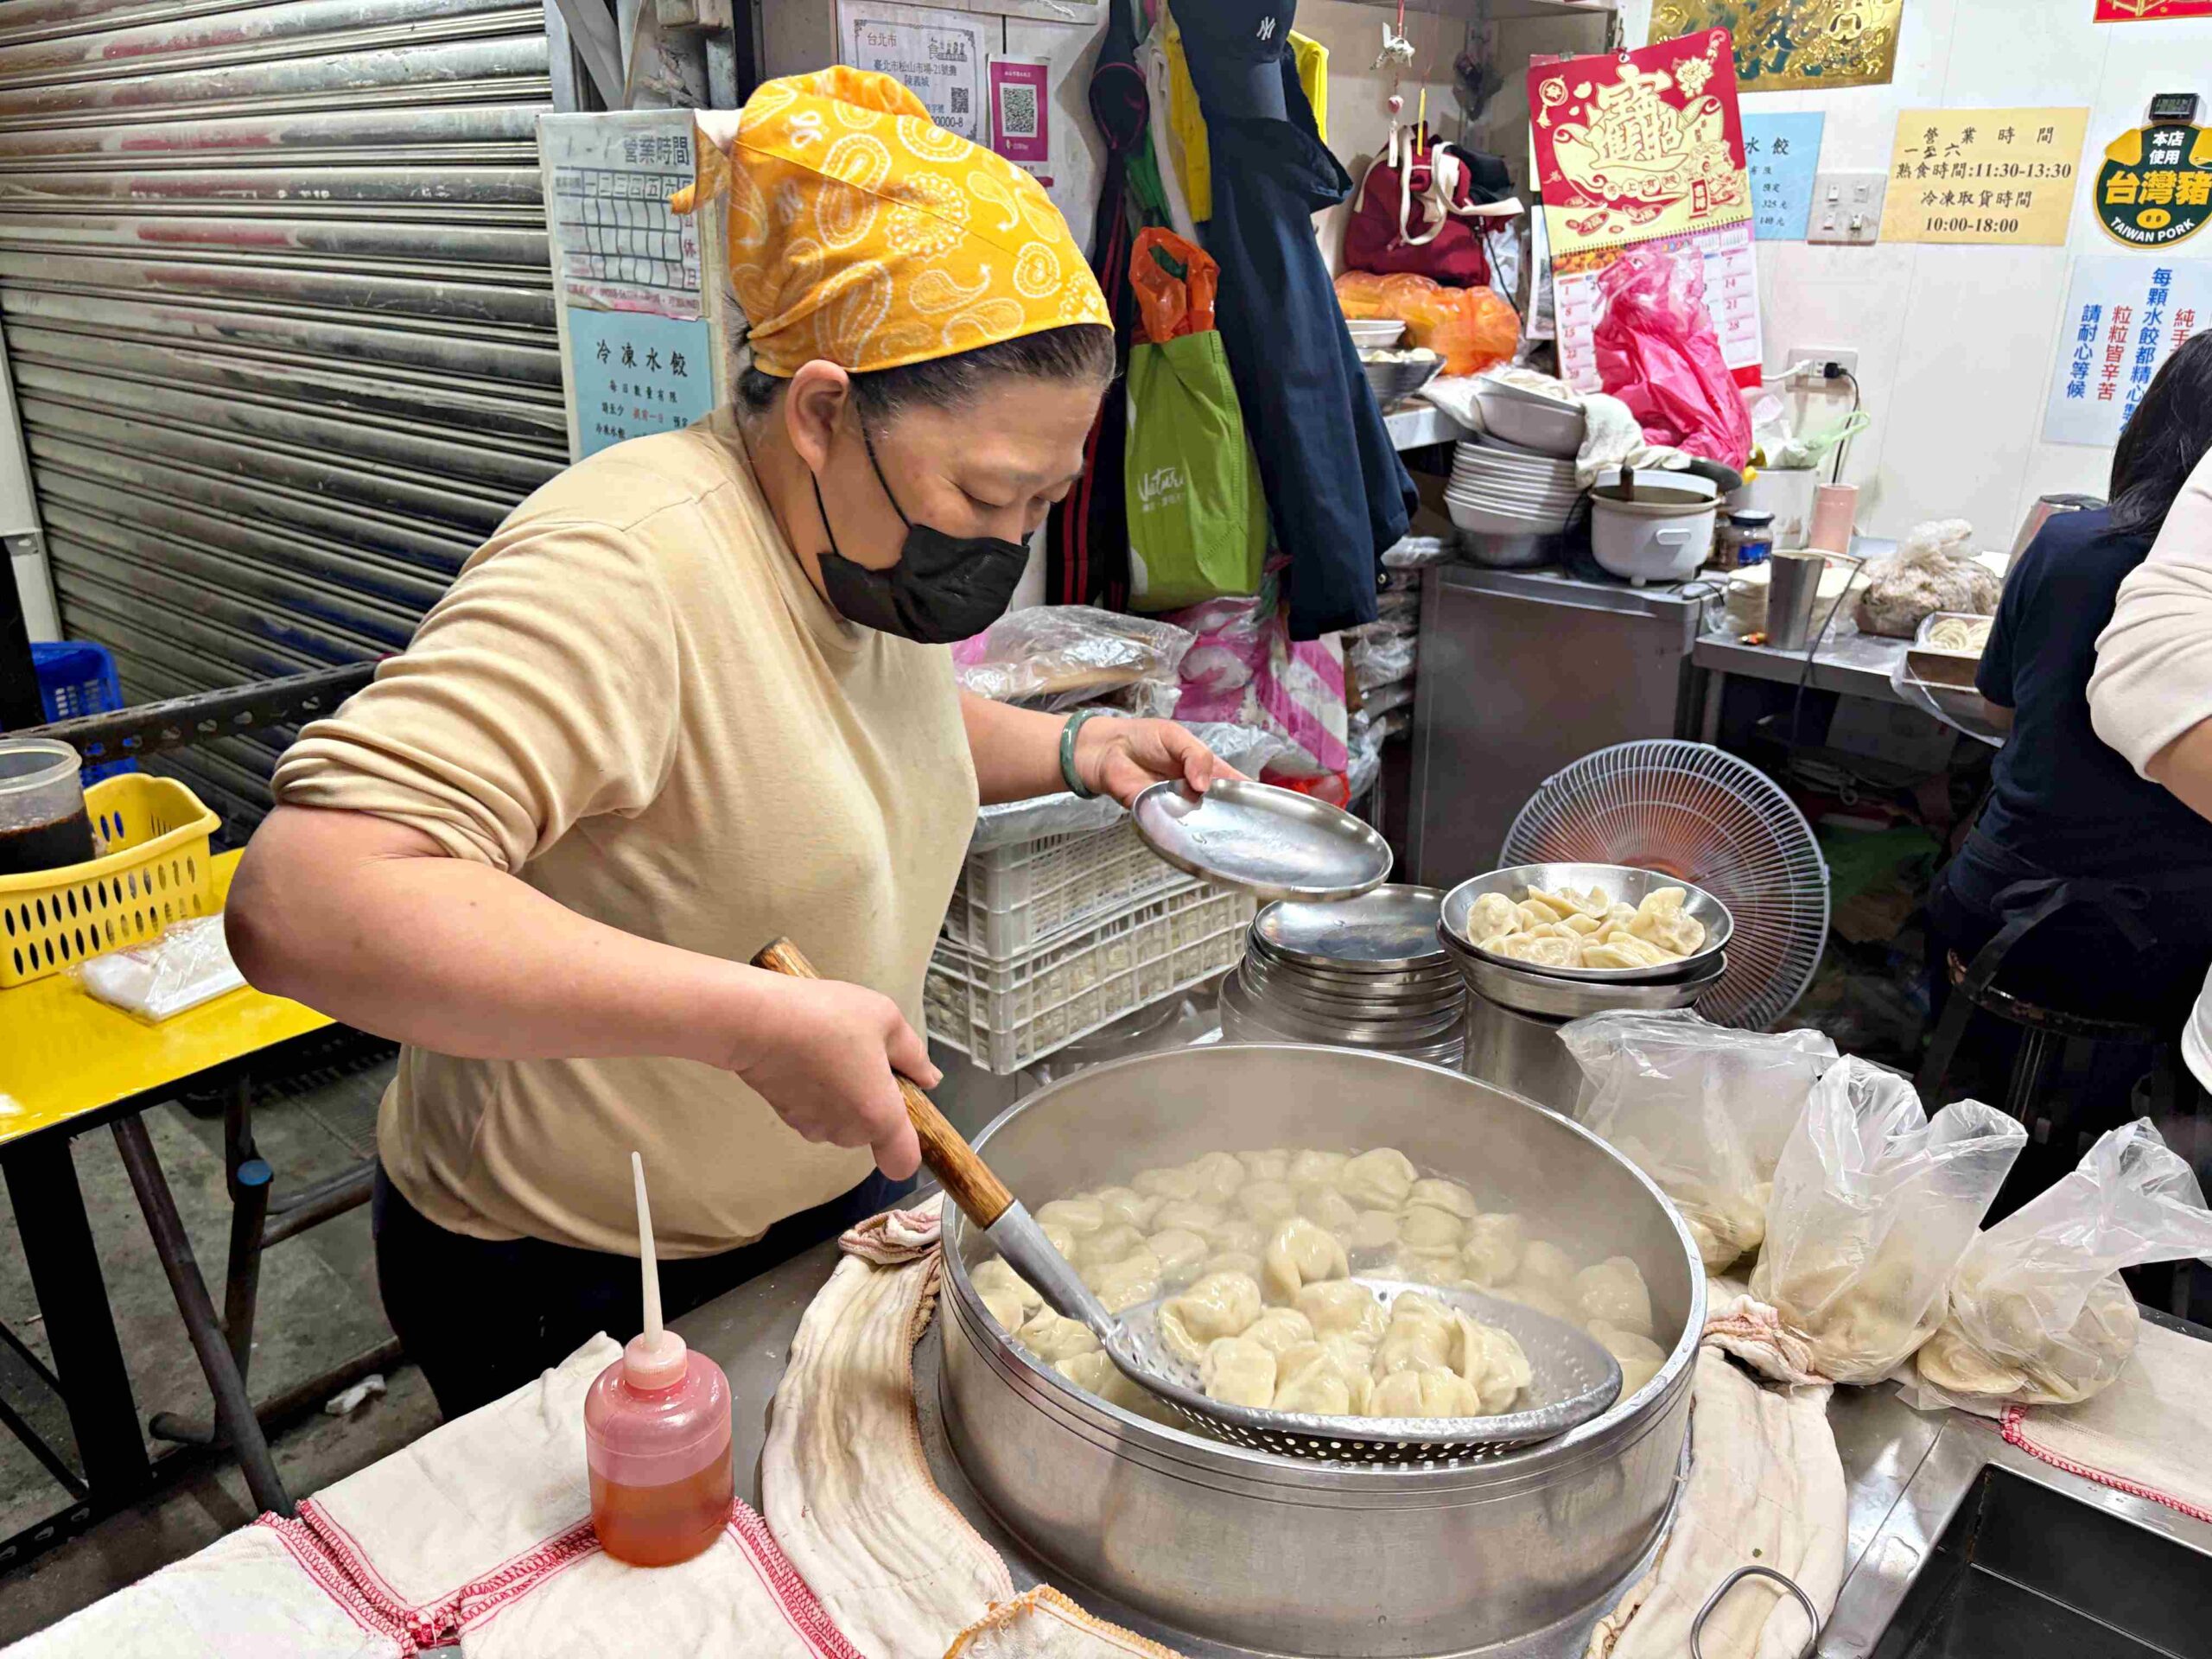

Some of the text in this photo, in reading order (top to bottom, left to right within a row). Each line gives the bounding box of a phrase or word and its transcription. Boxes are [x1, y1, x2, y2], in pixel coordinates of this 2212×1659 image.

[1923, 126, 2055, 144] 營業時間
[2152, 130, 2184, 147] 本店
[625, 136, 690, 165] 營業時間
[1904, 143, 1961, 159] 一至六
[2149, 149, 2181, 165] 使用
[1920, 189, 2033, 208] 冷凍取貨時間
[2105, 169, 2212, 206] 台灣豬
[1925, 216, 2019, 233] 10:00-18:00
[2110, 216, 2196, 243] TAIWAN PORK
[596, 339, 689, 378] 冷凍水餃
[2067, 304, 2101, 398] 請耐心等候
[2098, 305, 2132, 401] 粒粒皆辛苦
[2119, 267, 2172, 432] 每顆水餃都精心製
